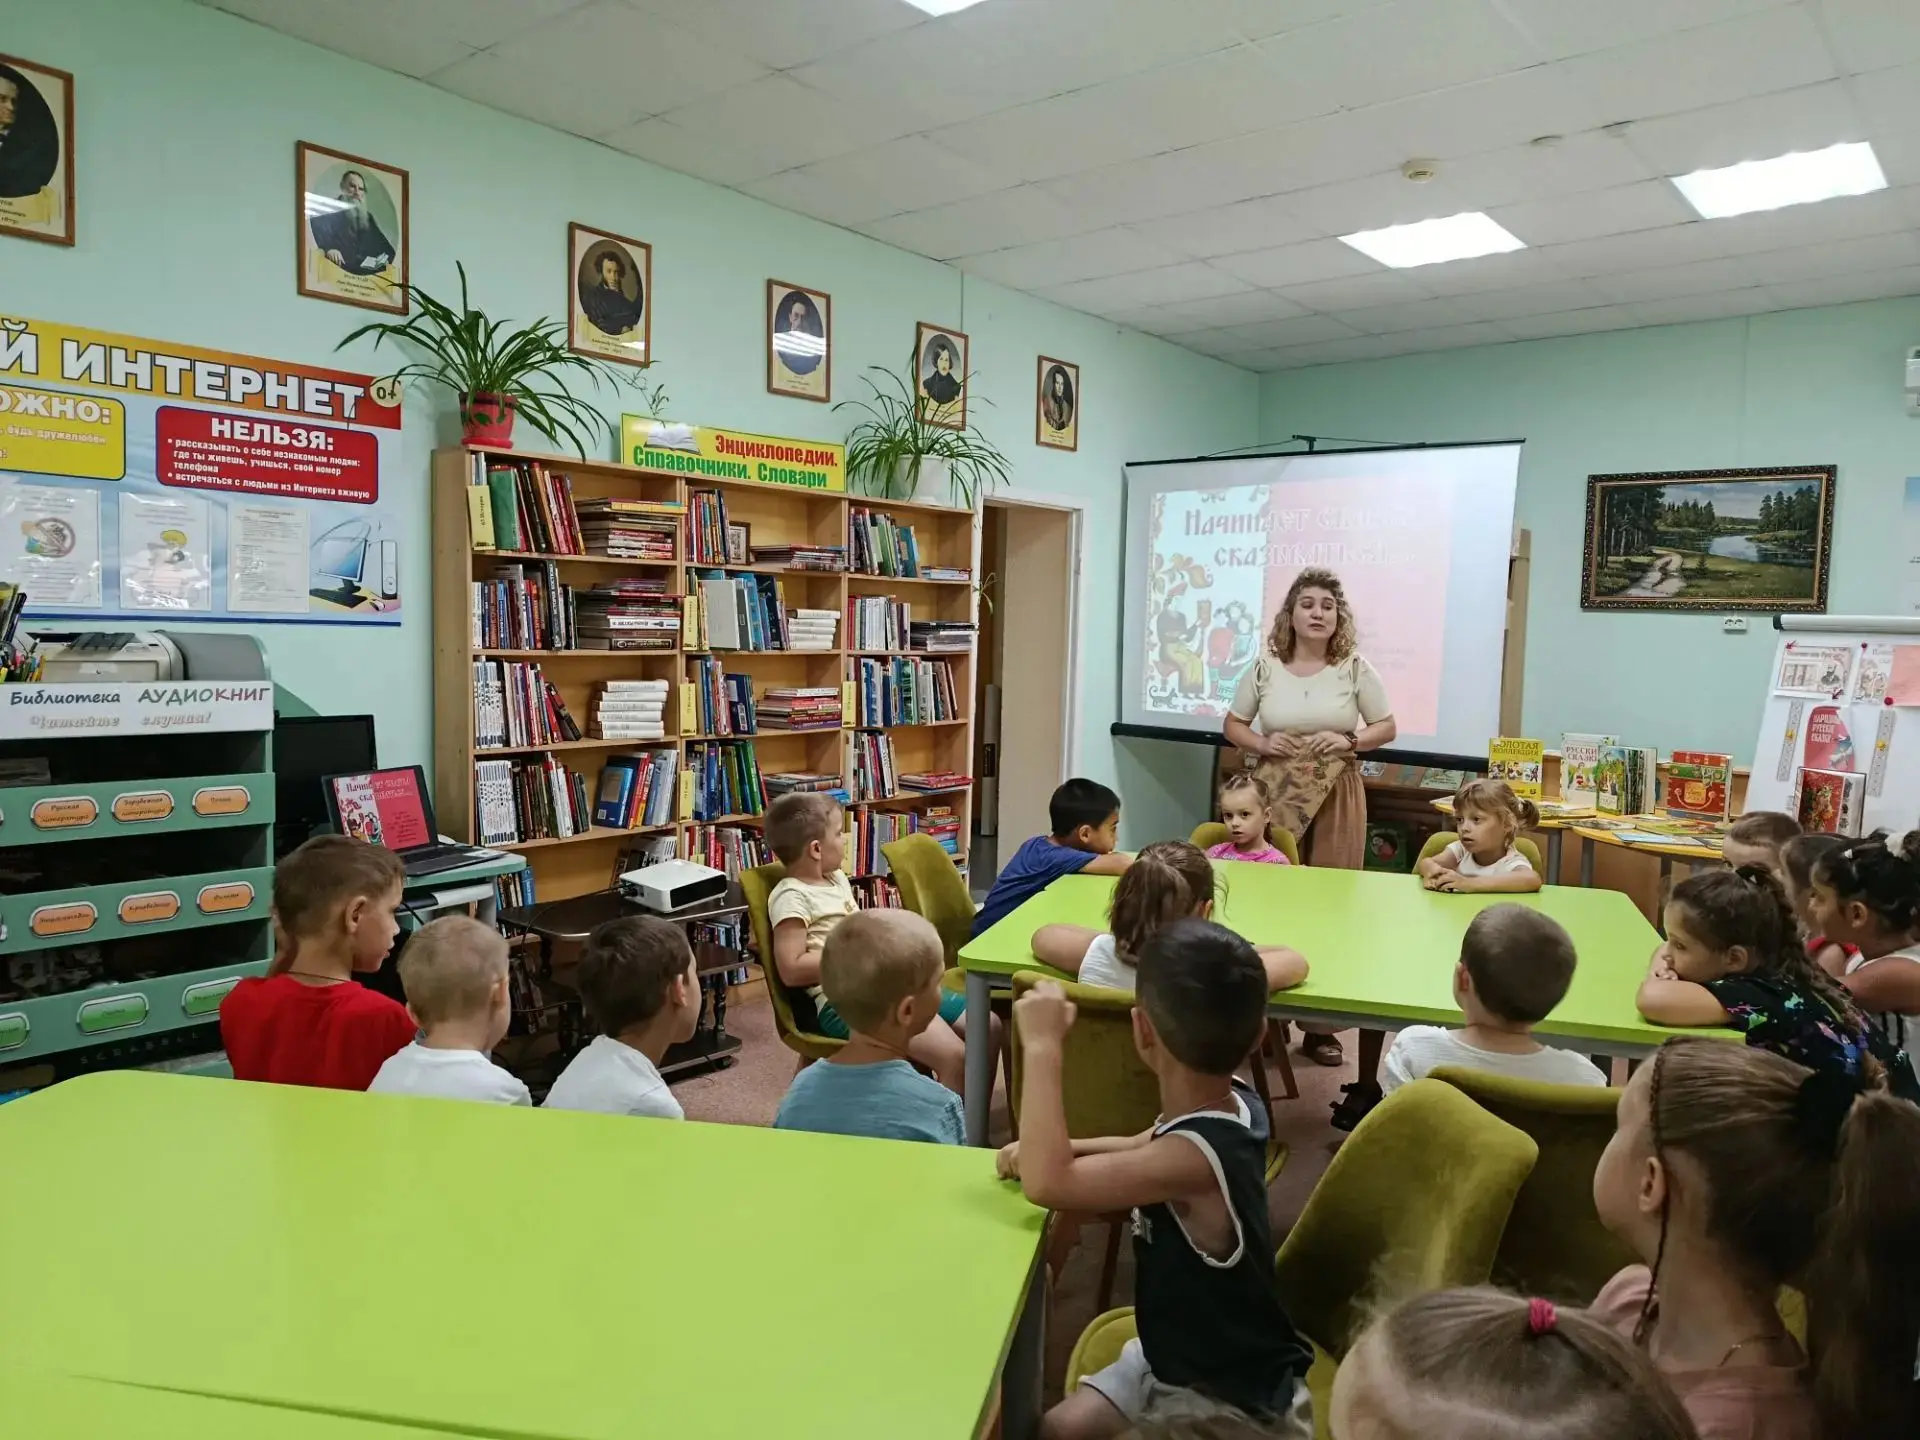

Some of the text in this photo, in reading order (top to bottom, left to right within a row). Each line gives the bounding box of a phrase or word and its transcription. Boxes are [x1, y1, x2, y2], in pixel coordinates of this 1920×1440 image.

[61, 337, 365, 420] ИНТЕРНЕТ
[375, 385, 398, 401] 0+
[211, 417, 334, 451] НЕЛЬЗЯ:
[175, 439, 241, 454] рассказывать
[251, 447, 272, 457] себе
[715, 434, 838, 467] Энциклопедии.
[173, 451, 341, 476] где ты живешь, учишься, свой номер
[173, 461, 219, 474] телефона
[633, 445, 828, 488] Справочники. Словари
[175, 473, 232, 487] встречаться
[243, 480, 279, 491] людьми
[281, 484, 291, 492] из
[293, 483, 336, 496] Интернета
[10, 687, 271, 707] Библиотека АУДИОКНИГ
[1566, 746, 1597, 755] РУССКИ
